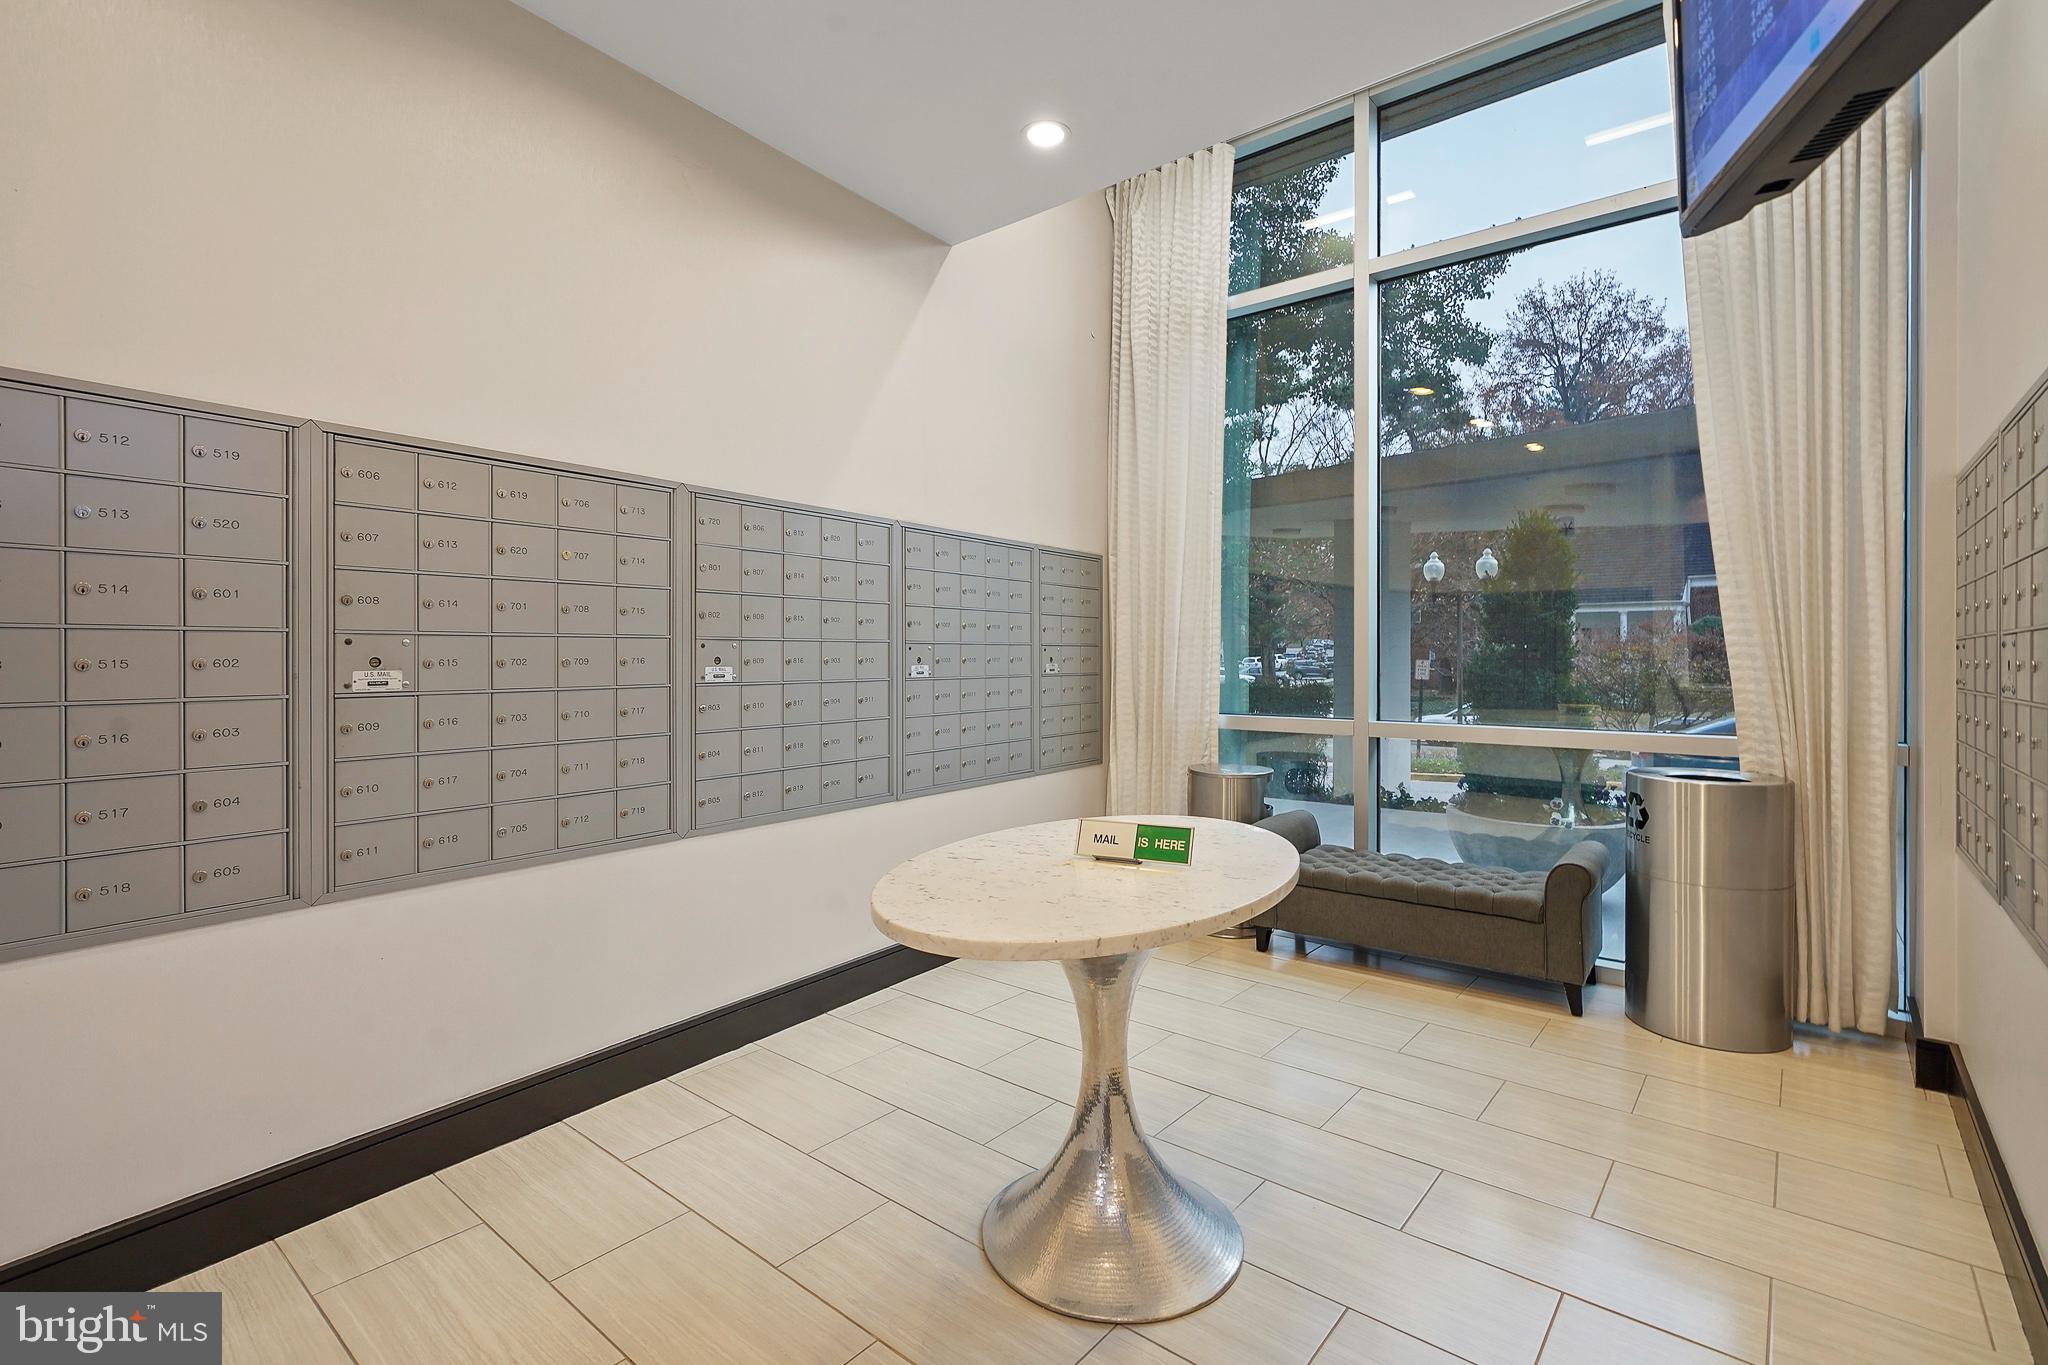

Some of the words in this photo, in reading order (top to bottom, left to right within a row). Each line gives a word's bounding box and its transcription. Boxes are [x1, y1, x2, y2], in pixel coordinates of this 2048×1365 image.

[98, 432, 130, 447] 512
[212, 448, 240, 461] 519
[357, 469, 380, 481] 606
[437, 480, 458, 491] 612
[509, 490, 528, 500] 619
[573, 499, 590, 509] 706
[97, 507, 130, 520] 513
[630, 506, 646, 516] 713
[212, 518, 240, 530] 520
[708, 518, 721, 526] 720
[356, 532, 379, 543] 607
[437, 538, 458, 550] 613
[509, 545, 528, 556] 620
[573, 551, 590, 561] 707
[630, 556, 646, 566] 714
[708, 564, 721, 572] 801
[97, 583, 129, 595] 514
[212, 588, 239, 599] 601
[356, 595, 380, 605] 608
[438, 599, 459, 609] 614
[509, 601, 528, 611] 701
[573, 604, 590, 613] 708
[630, 606, 646, 615] 715
[707, 611, 721, 619] 802
[97, 658, 129, 670] 515
[212, 658, 240, 668] 602
[438, 657, 459, 667] 615
[509, 657, 528, 666] 702
[573, 657, 590, 666] 709
[630, 657, 646, 665] 716
[707, 703, 721, 711] 803
[792, 699, 804, 707] 817
[573, 710, 590, 719] 710
[630, 707, 646, 716] 717
[438, 716, 459, 727] 616
[509, 713, 528, 722] 703
[212, 727, 240, 738] 603
[356, 722, 380, 733] 609
[98, 733, 130, 745] 516
[707, 750, 721, 758] 804
[752, 746, 765, 754] 811
[630, 757, 646, 766] 718
[573, 762, 590, 772] 711
[509, 768, 528, 778] 704
[438, 775, 458, 786] 617
[356, 783, 379, 795] 610
[751, 790, 764, 798] 812
[212, 796, 241, 808] 604
[98, 807, 129, 821] 517
[630, 806, 646, 816] 719
[573, 814, 590, 825] 712
[509, 824, 528, 834] 705
[438, 834, 459, 845] 618
[1093, 833, 1119, 846] MAIL
[1137, 837, 1149, 848] IS
[1155, 838, 1186, 851] HERE
[356, 845, 379, 858] 611
[212, 865, 241, 878] 605
[100, 882, 131, 896] 518
